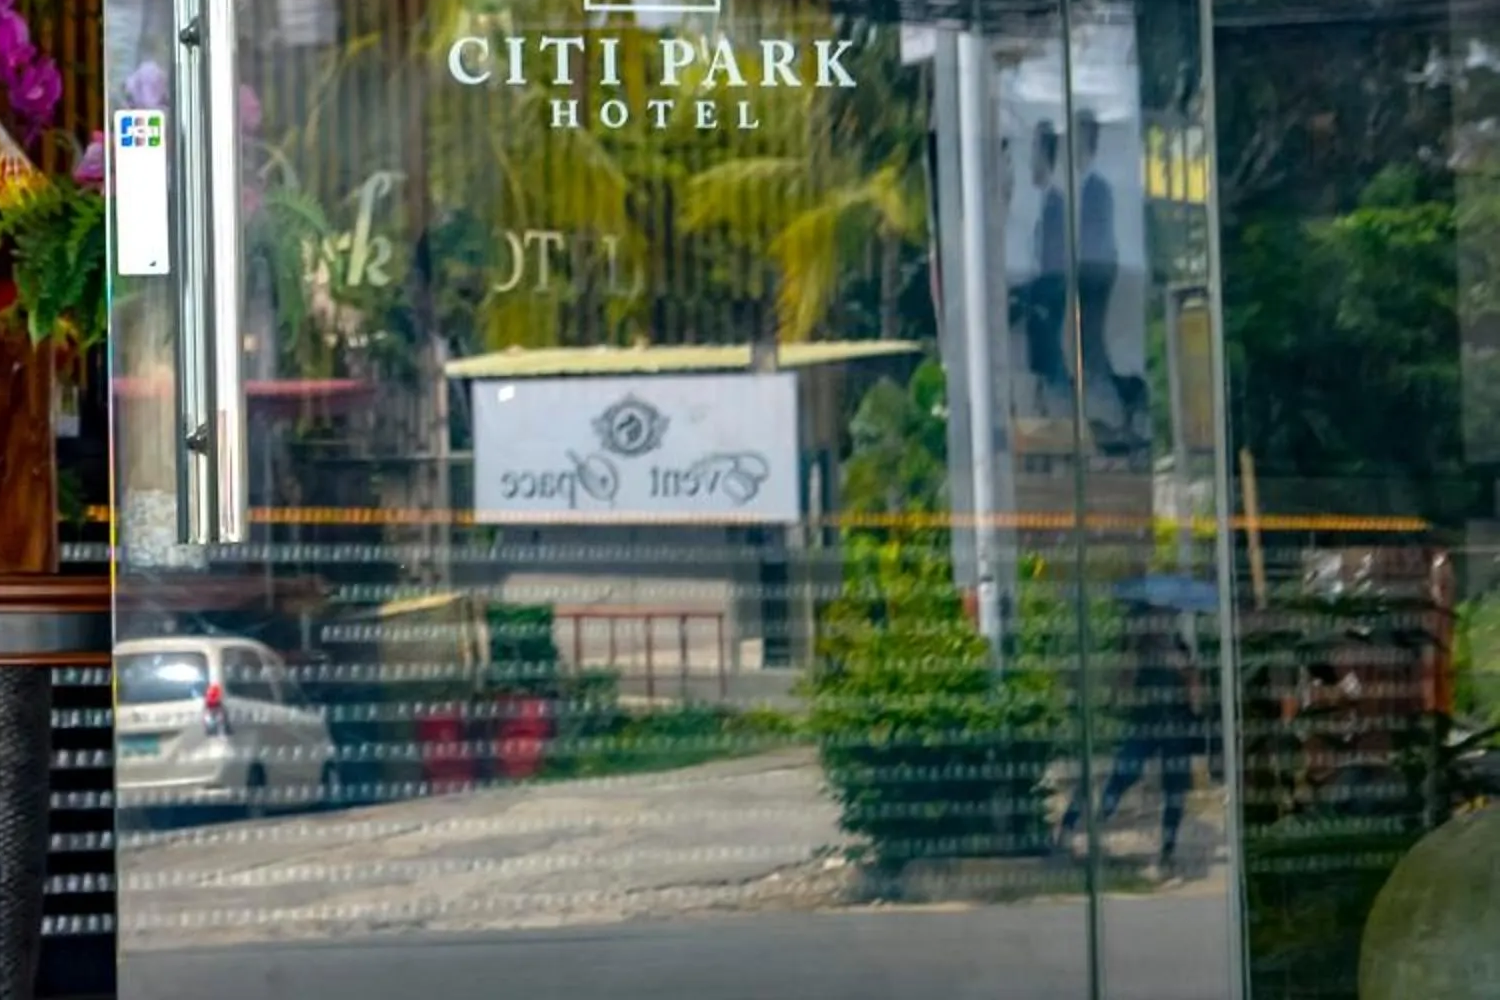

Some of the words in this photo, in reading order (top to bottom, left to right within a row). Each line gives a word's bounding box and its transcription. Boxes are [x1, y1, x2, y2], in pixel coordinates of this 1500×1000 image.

[448, 36, 621, 86] CITI
[660, 34, 857, 88] PARK
[550, 100, 759, 129] HOTEL
